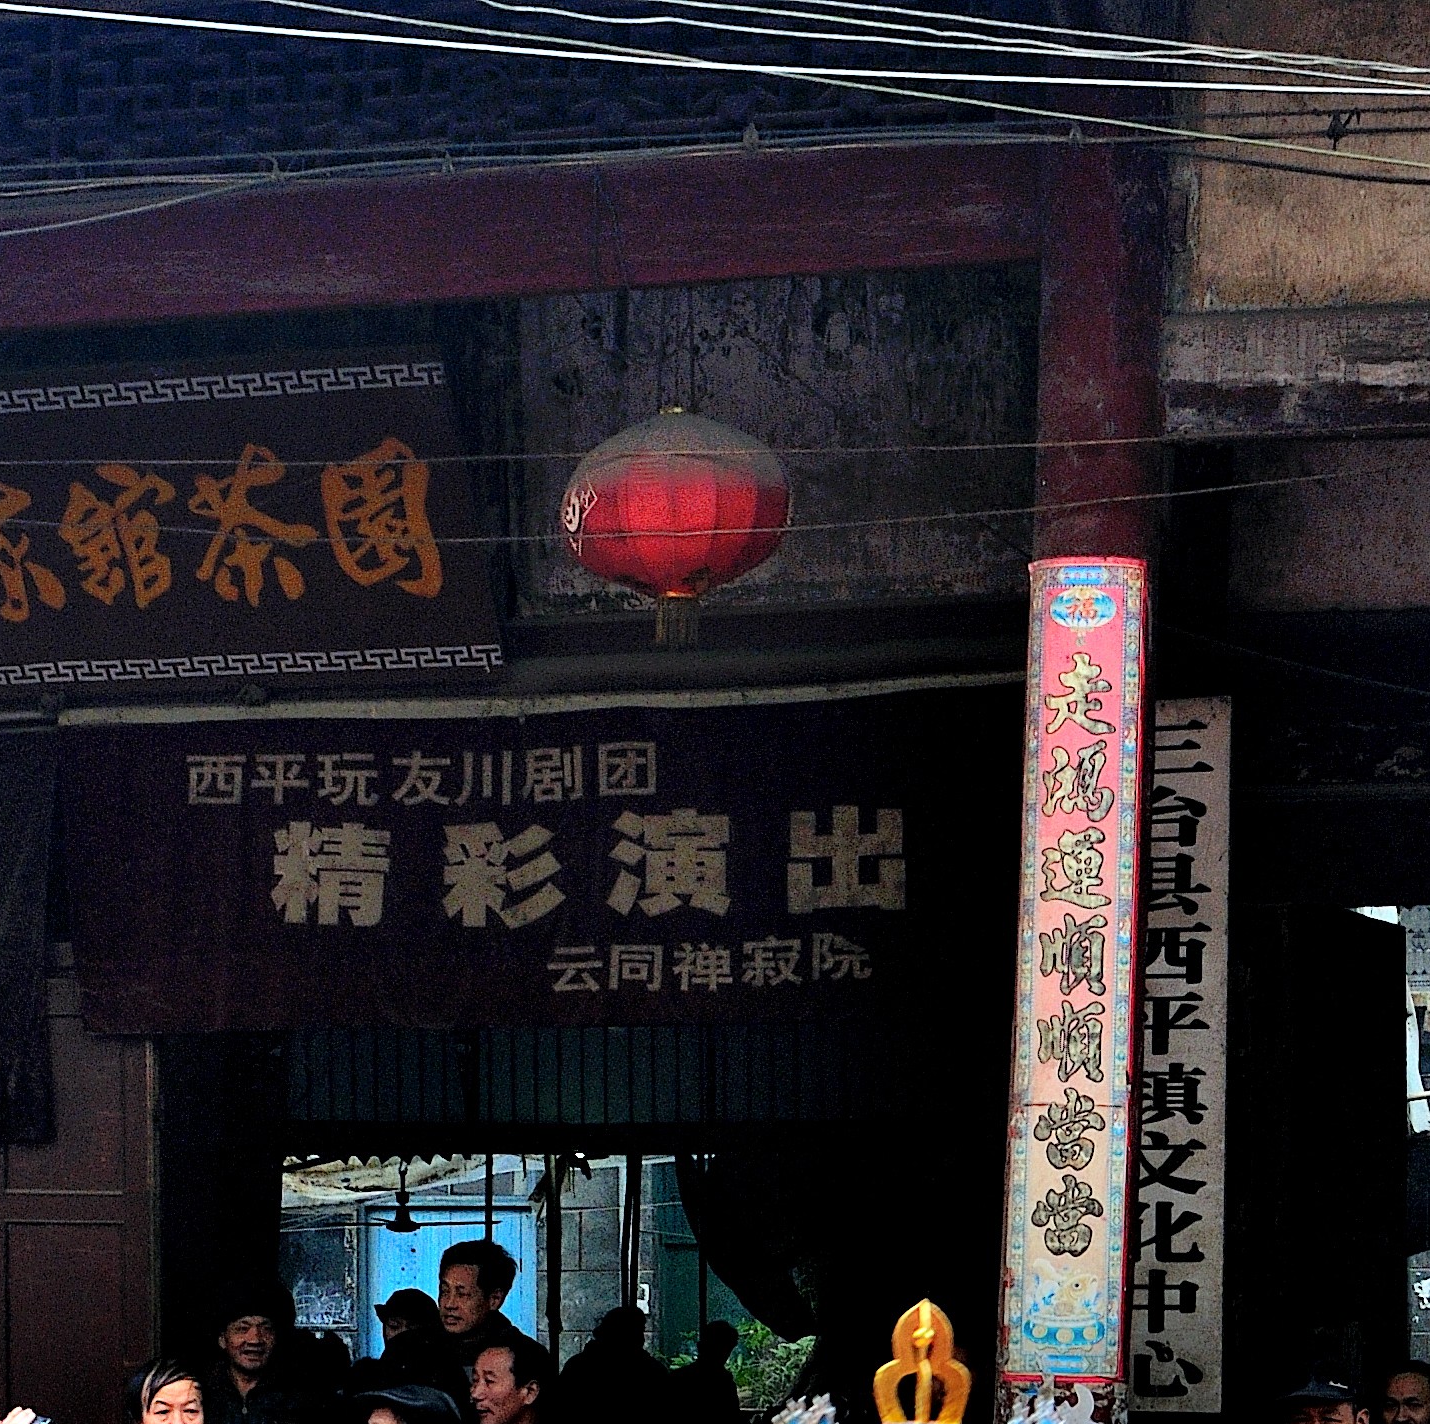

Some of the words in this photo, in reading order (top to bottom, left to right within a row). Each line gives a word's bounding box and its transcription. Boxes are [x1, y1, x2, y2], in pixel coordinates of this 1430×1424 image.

[185, 740, 658, 807] 西平玩友川剧团
[272, 805, 906, 931] 精彩演出
